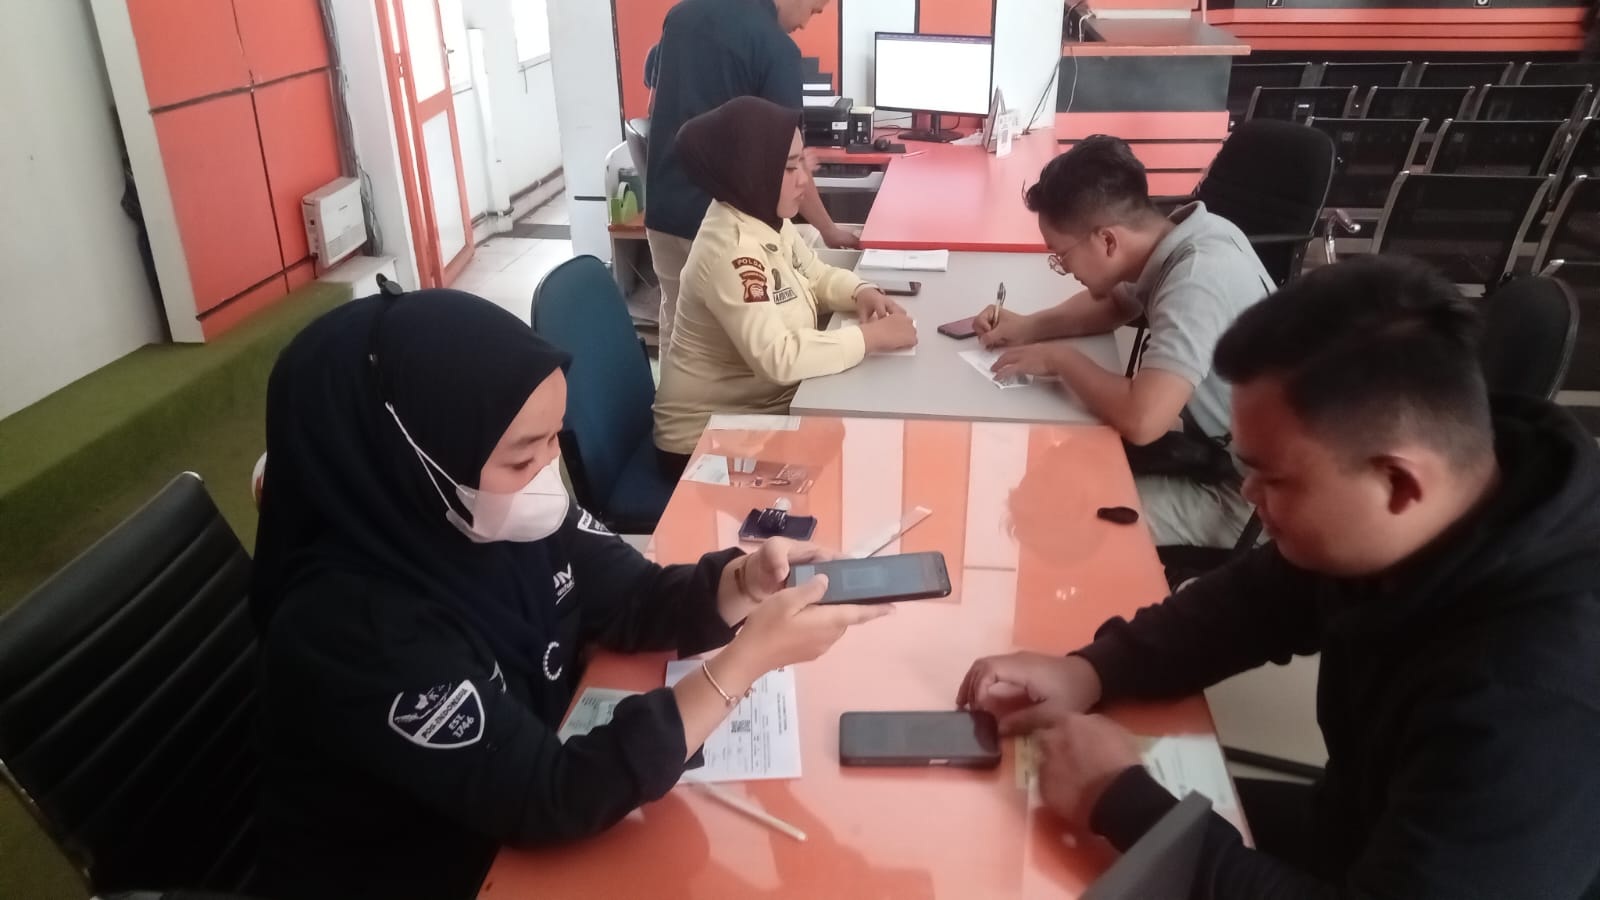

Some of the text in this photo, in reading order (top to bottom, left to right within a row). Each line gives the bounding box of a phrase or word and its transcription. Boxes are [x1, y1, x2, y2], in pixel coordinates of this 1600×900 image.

[737, 258, 762, 269] POLDA
[421, 723, 437, 739] POS
[452, 716, 475, 738] 1746
